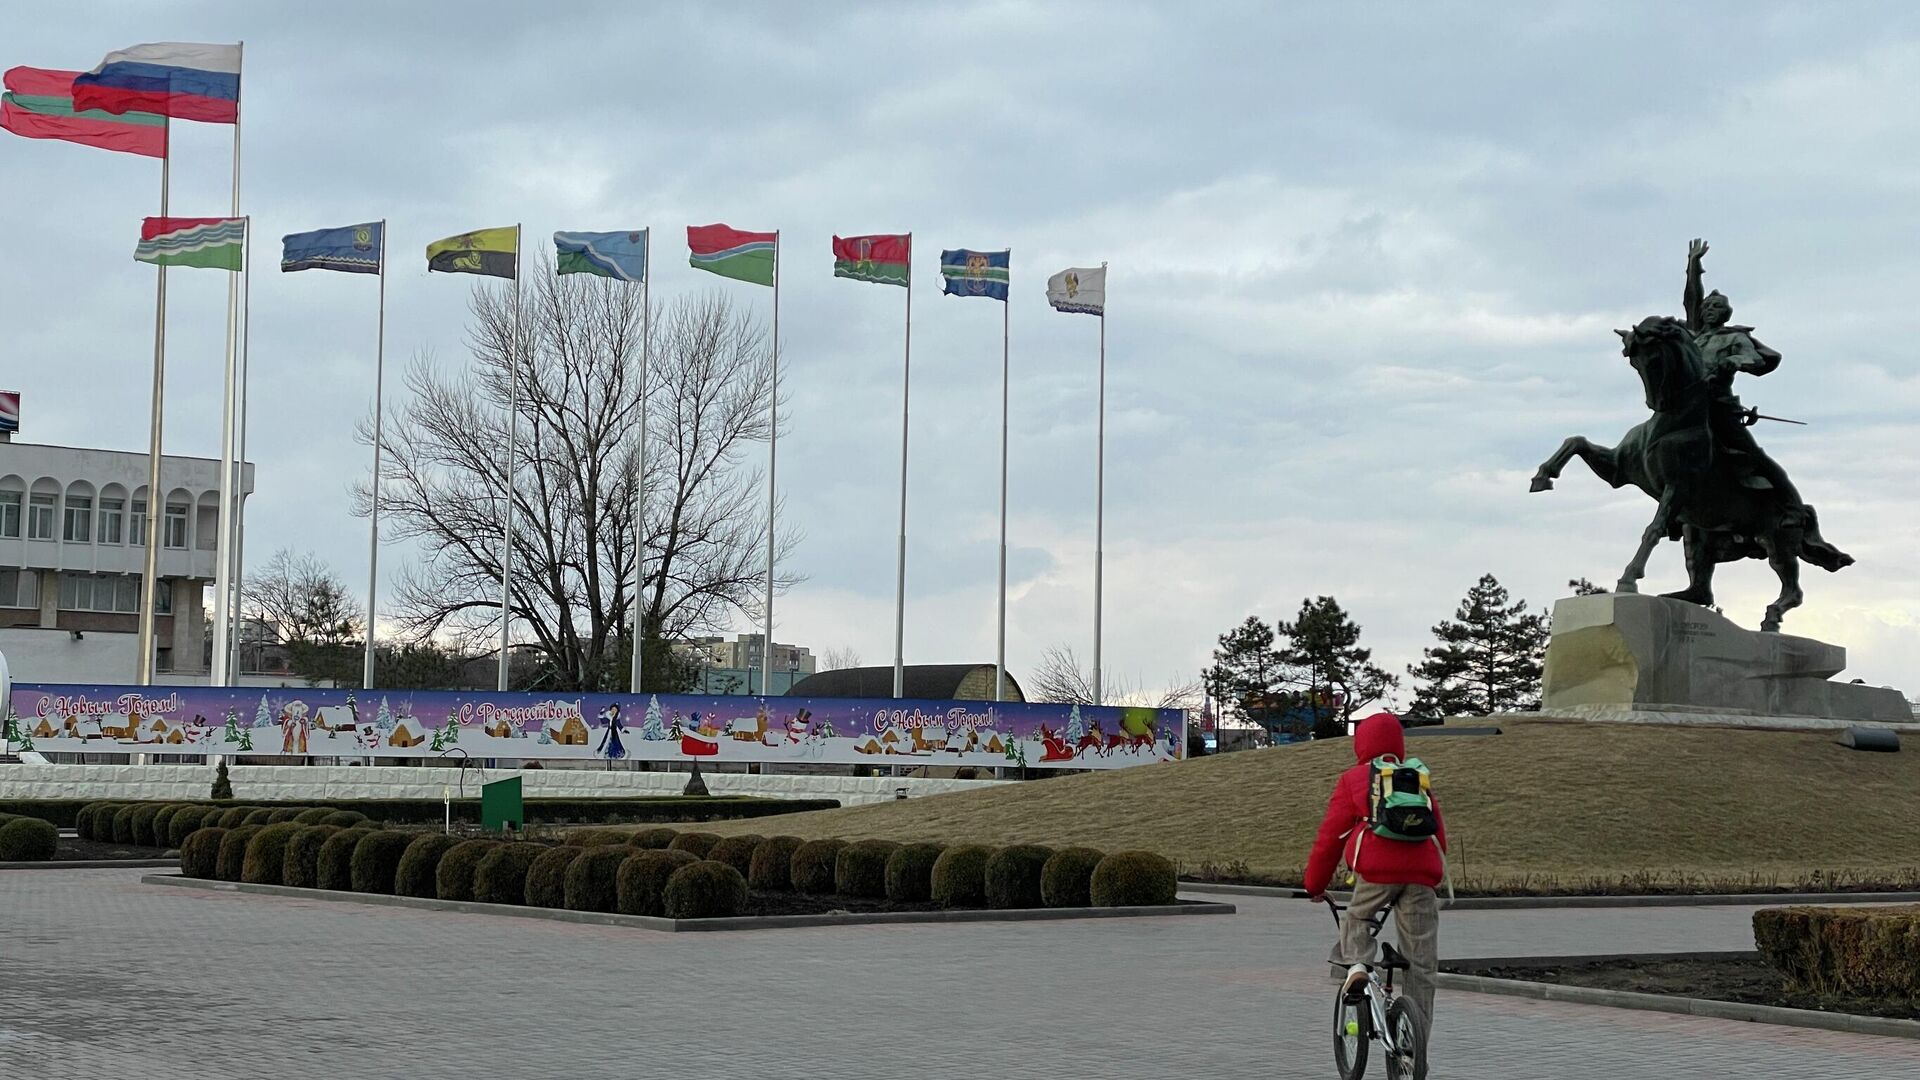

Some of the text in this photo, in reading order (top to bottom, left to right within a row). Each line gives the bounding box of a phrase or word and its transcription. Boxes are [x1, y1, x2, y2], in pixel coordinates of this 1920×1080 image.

[36, 692, 177, 719] С Новым Годом!
[459, 699, 581, 727] С Рождеством!
[874, 706, 994, 731] С Новым Годом!
